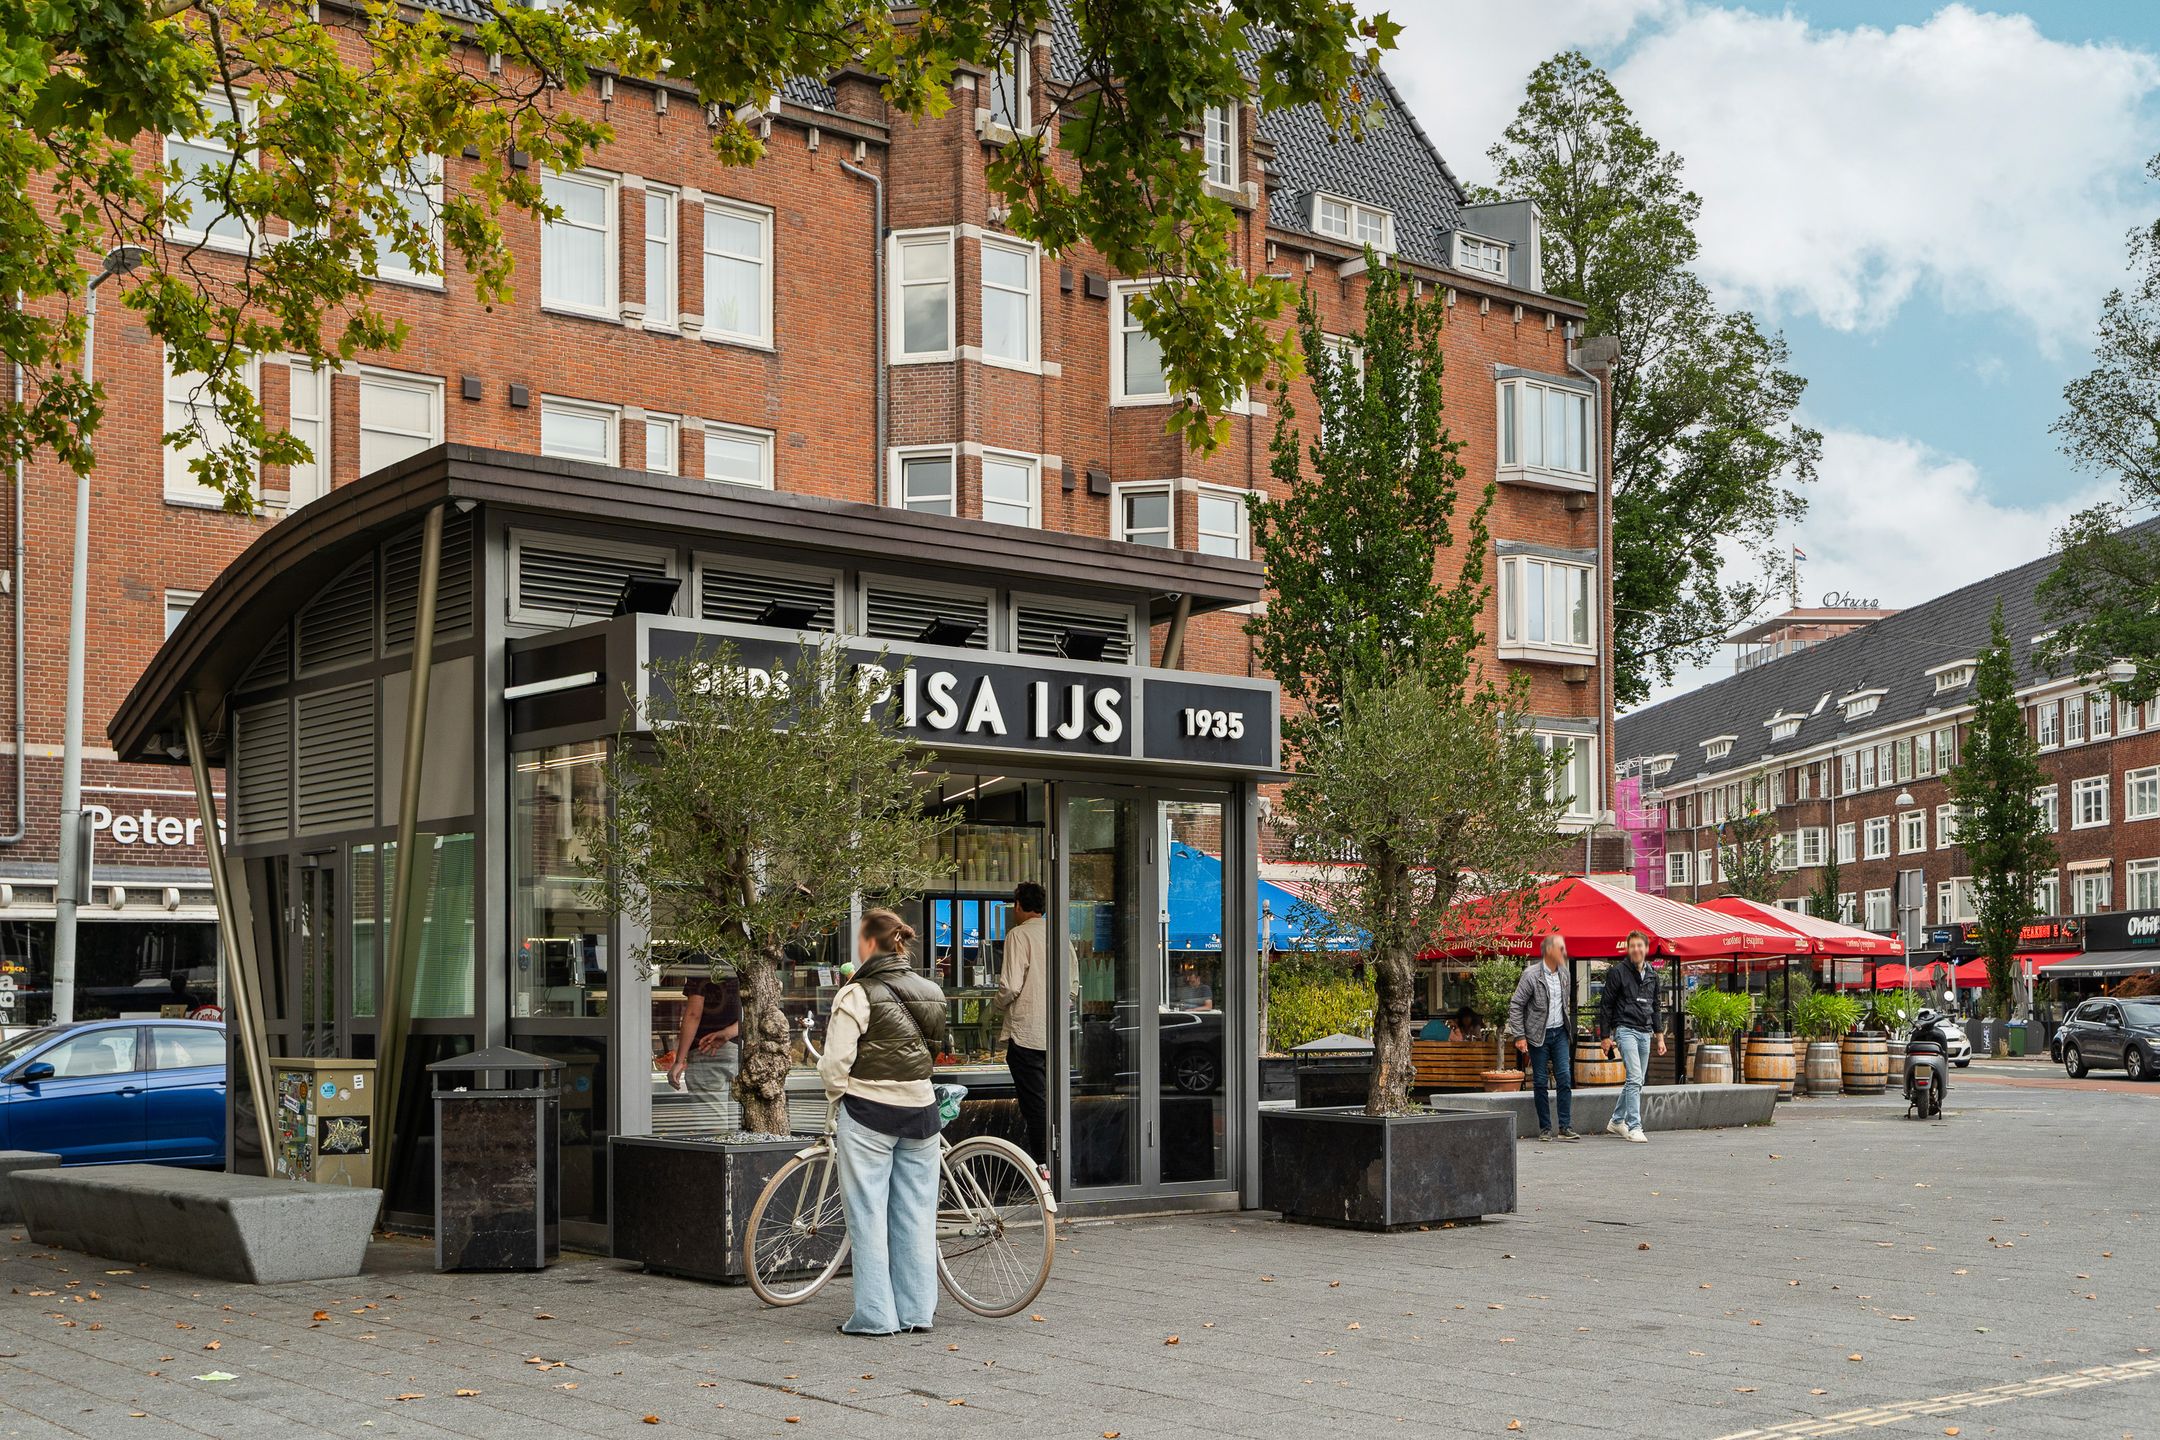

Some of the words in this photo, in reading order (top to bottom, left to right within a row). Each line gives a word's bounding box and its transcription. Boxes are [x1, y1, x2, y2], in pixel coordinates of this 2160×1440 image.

[856, 662, 1008, 736] PISA
[1034, 680, 1124, 744] IJS
[1185, 707, 1244, 740] 1935
